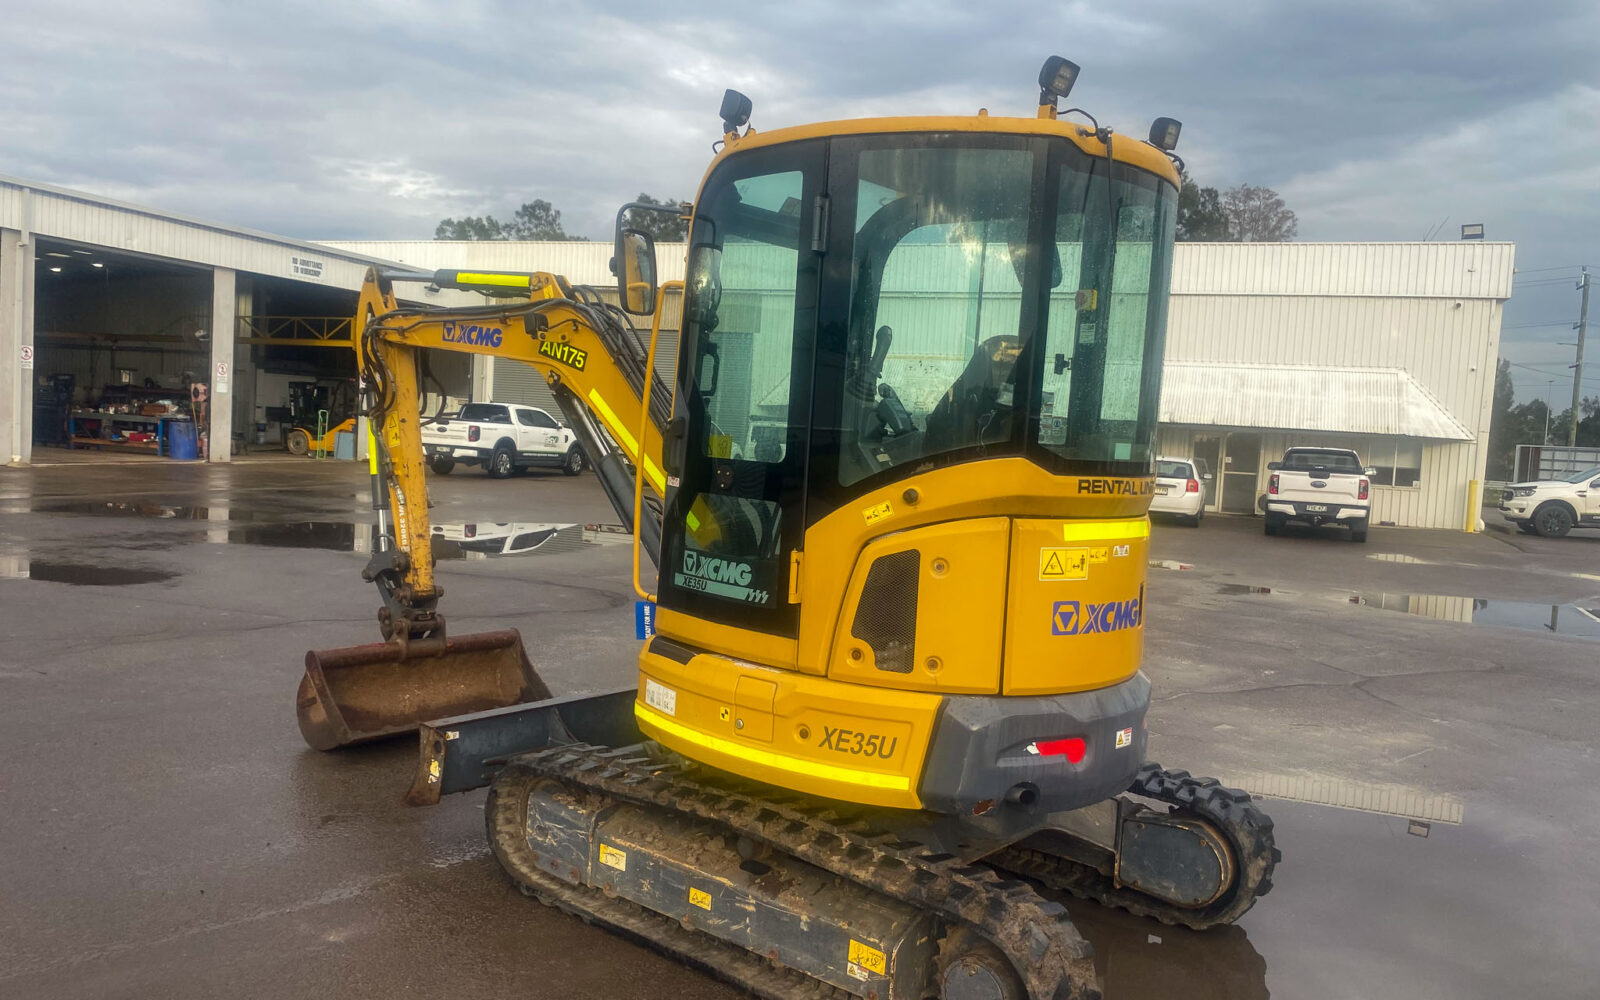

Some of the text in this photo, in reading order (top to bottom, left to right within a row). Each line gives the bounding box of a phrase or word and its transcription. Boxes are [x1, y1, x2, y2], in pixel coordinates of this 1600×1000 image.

[456, 324, 503, 348] XCMG
[541, 341, 586, 368] AN175
[1078, 479, 1138, 495] RENTAL
[683, 576, 708, 591] XE35U
[696, 555, 752, 586] XCMG
[1079, 598, 1138, 635] XCMG
[818, 726, 898, 759] XE35U
